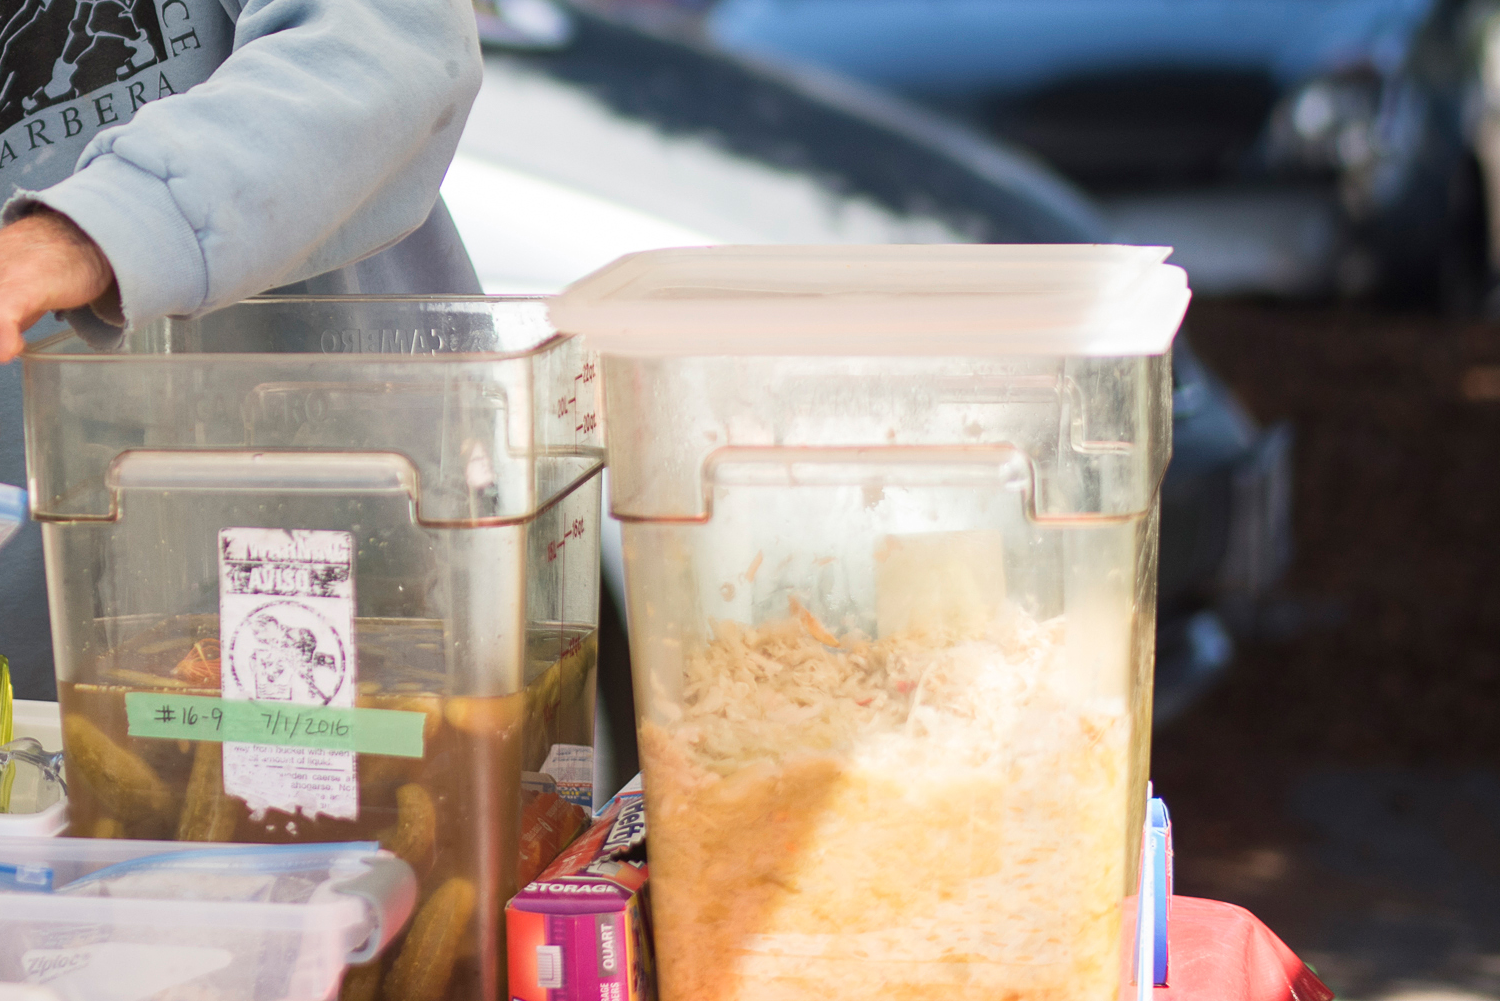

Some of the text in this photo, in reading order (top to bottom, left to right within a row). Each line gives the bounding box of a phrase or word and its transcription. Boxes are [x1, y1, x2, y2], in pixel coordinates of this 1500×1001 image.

[247, 565, 311, 593] AVISO
[261, 710, 349, 739] 7/1/2016
[523, 882, 619, 894] STORAGE
[600, 923, 615, 969] QUART
